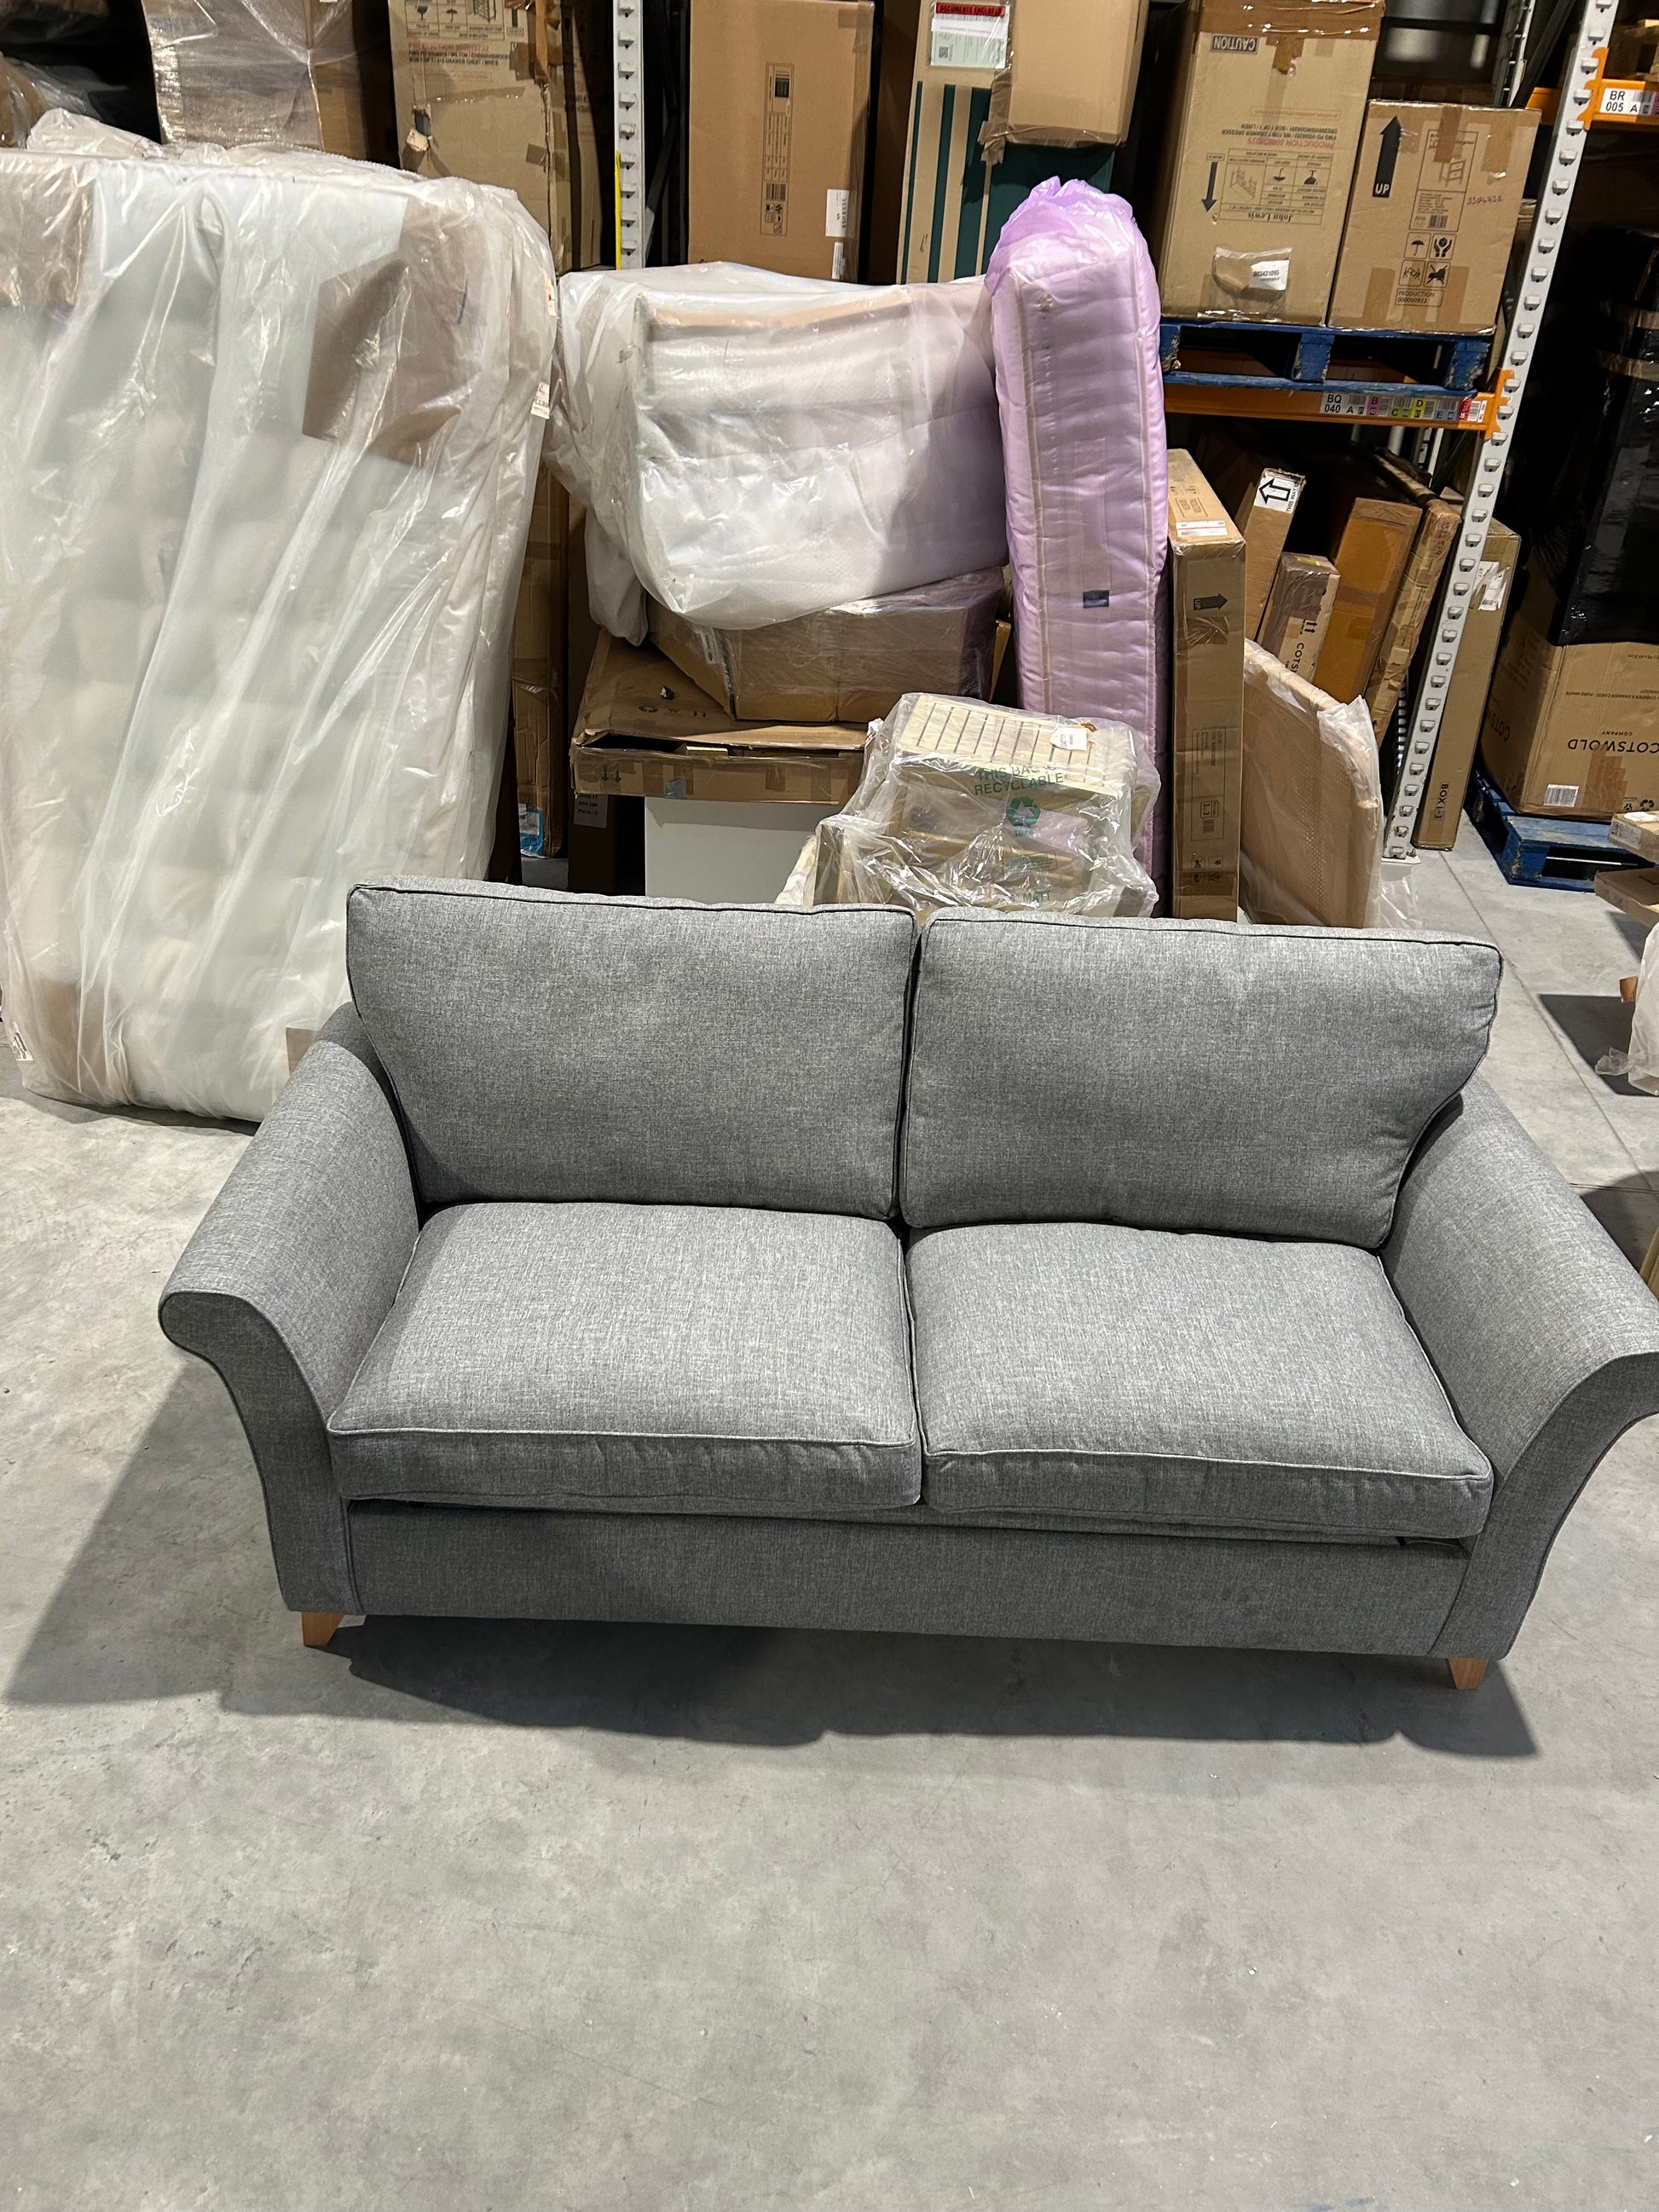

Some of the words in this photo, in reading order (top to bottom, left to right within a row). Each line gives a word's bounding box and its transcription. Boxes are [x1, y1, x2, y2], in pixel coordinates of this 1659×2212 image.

[1213, 36, 1255, 50] CAUTION
[1610, 90, 1625, 101] BR
[1606, 101, 1624, 113] 005
[1629, 104, 1638, 113] A
[1286, 139, 1333, 148] PRODUCTION
[1374, 182, 1389, 194] UP
[1247, 212, 1270, 221] Lewis
[1273, 213, 1292, 222] John
[1327, 394, 1342, 404] BQ
[1416, 399, 1424, 407] D
[1325, 404, 1341, 413] 040
[1391, 408, 1399, 417] C
[1436, 411, 1443, 419] E
[1194, 598, 1200, 609] UP
[1568, 738, 1659, 754] COTSWOLD
[978, 767, 1007, 782] THIS
[974, 772, 1065, 795] RECYCLABLE
[1437, 783, 1448, 804] BOX
[1023, 890, 1051, 904] MATT
